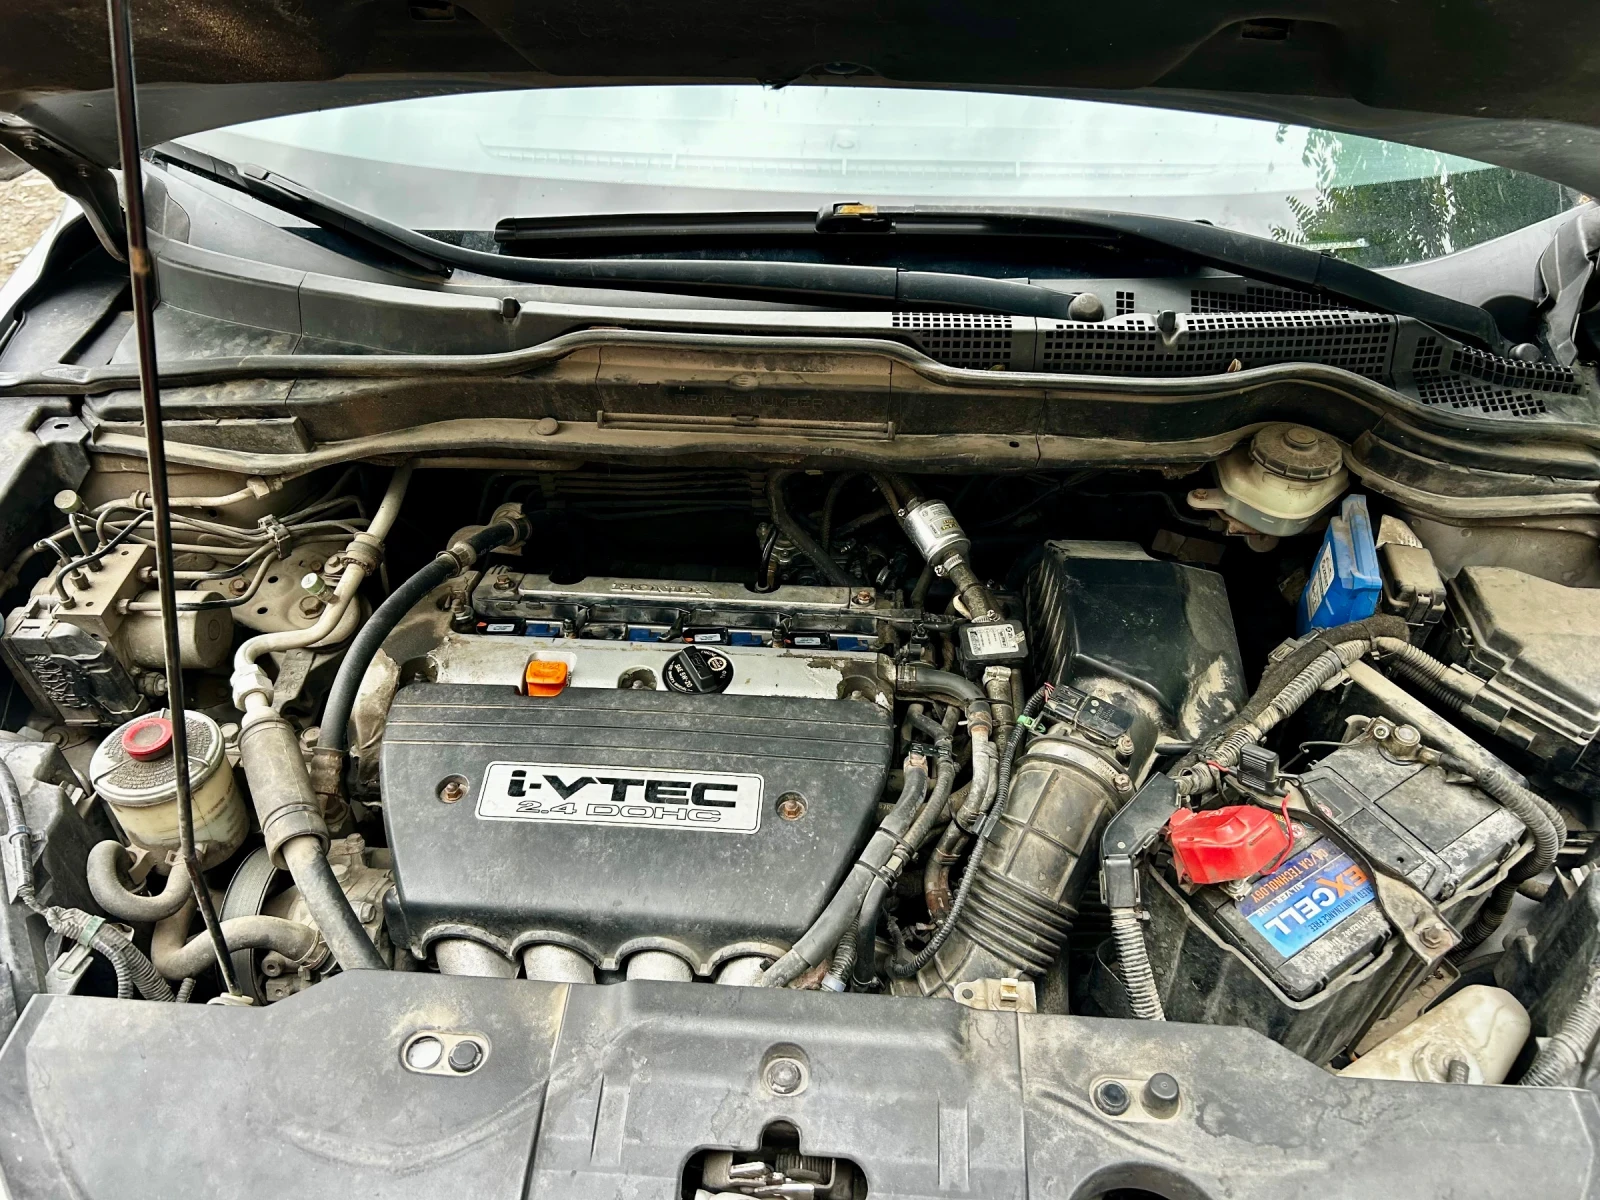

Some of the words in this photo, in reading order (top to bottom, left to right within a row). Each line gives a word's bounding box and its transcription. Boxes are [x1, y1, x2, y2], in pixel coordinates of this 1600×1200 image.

[611, 582, 715, 595] HONDA
[507, 769, 738, 808] i-VTEC
[516, 800, 577, 815] 2.4
[586, 803, 721, 822] DOHC
[1251, 865, 1303, 903] TECHNOLOGY
[1273, 882, 1305, 905] SILVER
[1254, 902, 1275, 918] LINE
[1263, 866, 1369, 935] EXCELL
[1321, 893, 1360, 925] MAINTENANCE
[1307, 918, 1324, 933] FREE
